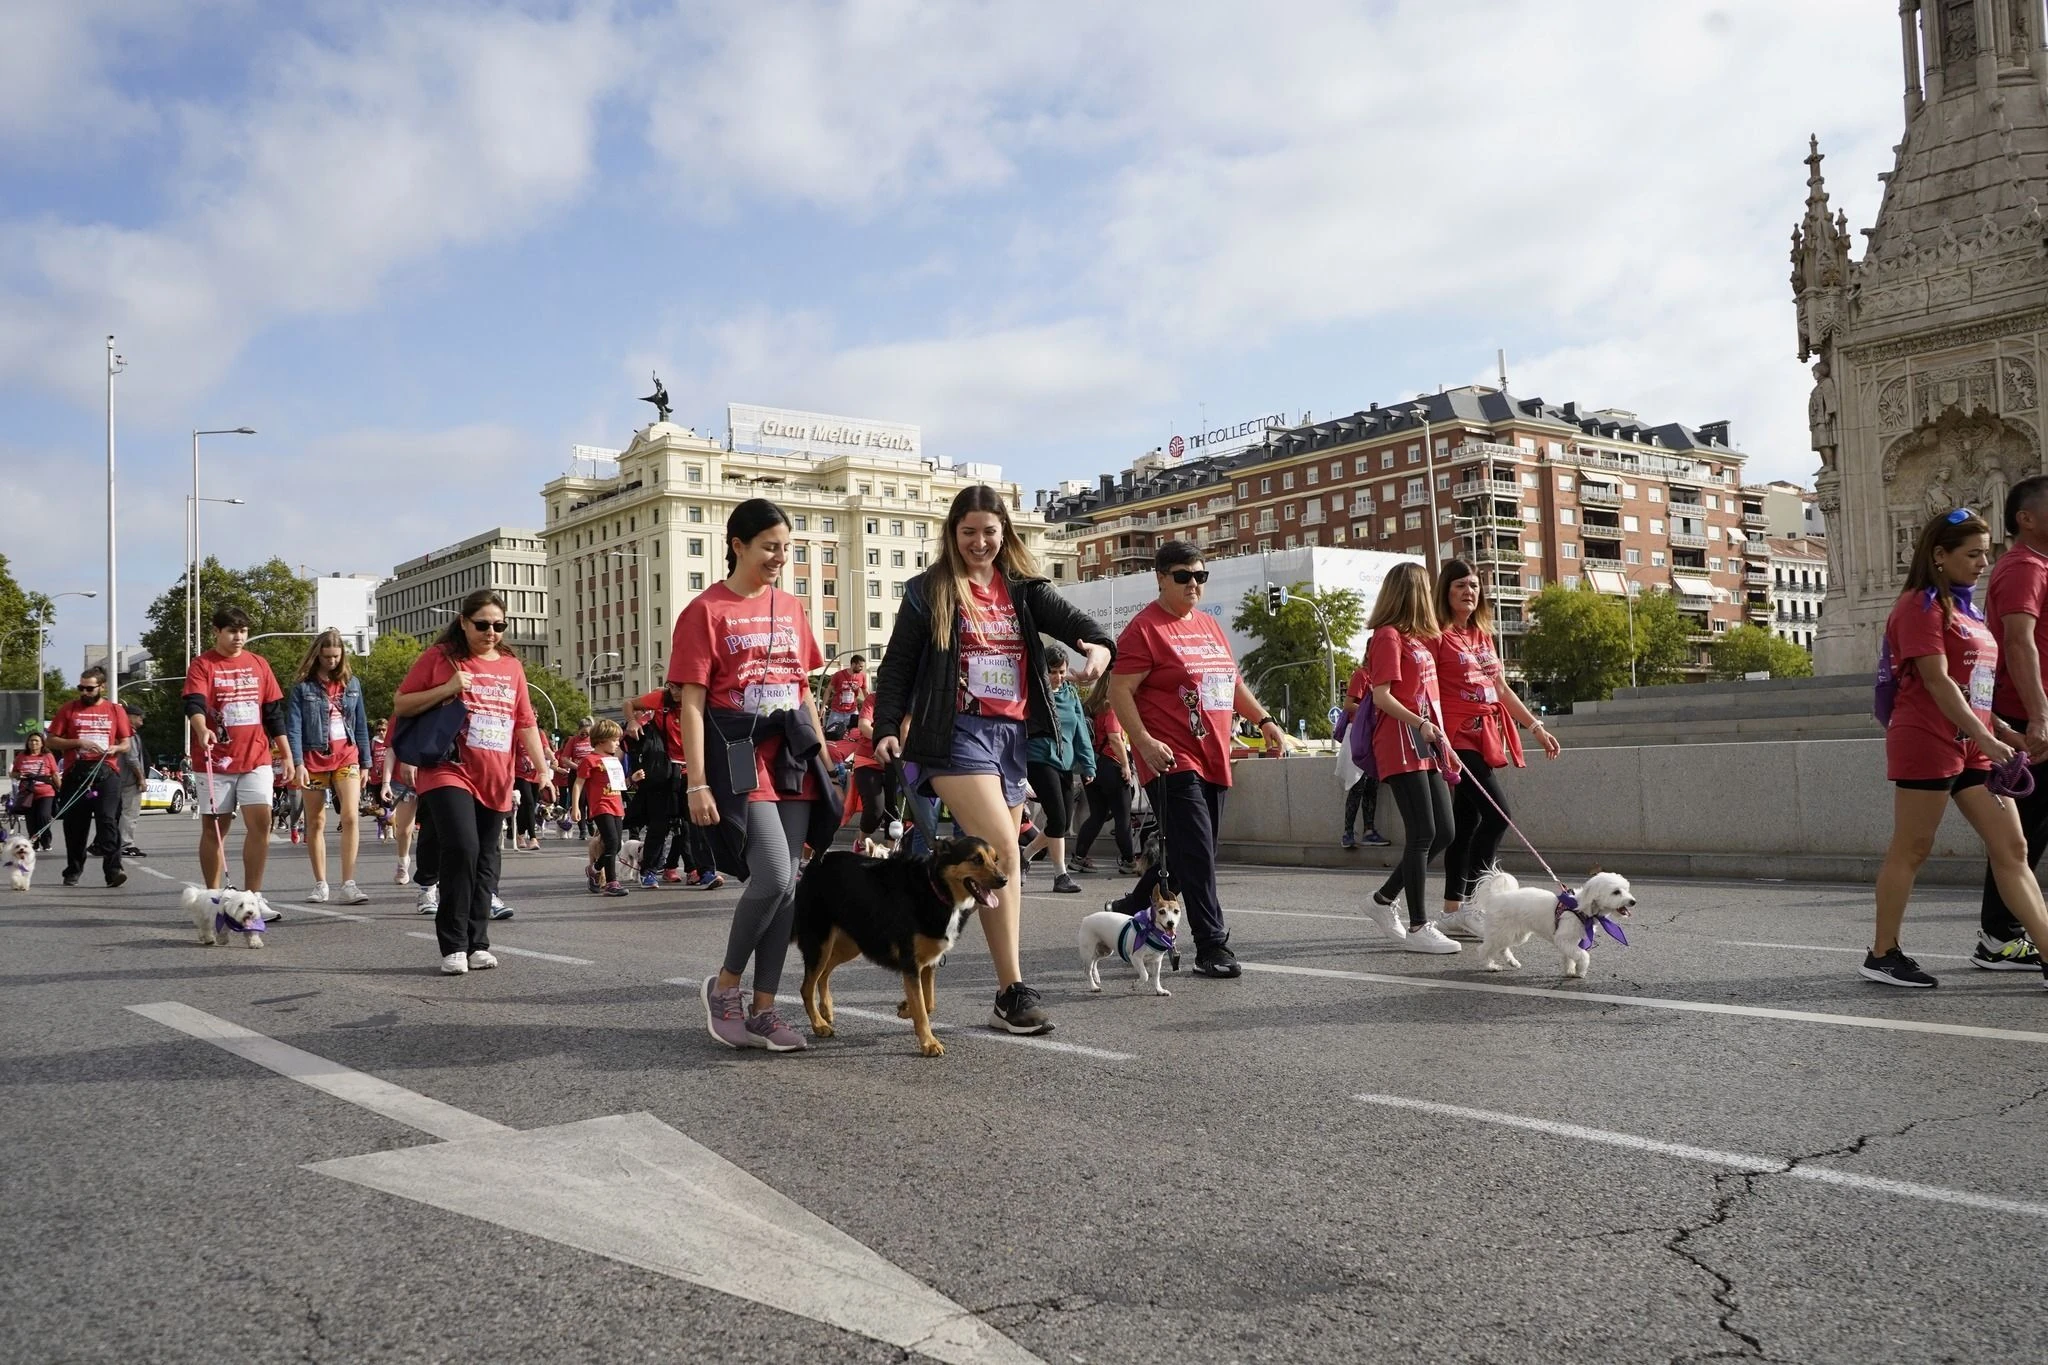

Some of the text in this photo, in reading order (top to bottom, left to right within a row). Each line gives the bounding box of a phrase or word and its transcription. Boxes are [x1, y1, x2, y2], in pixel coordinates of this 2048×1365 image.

[762, 417, 806, 439] Gran
[1207, 412, 1286, 445] COLLECTION
[1097, 607, 1108, 617] los
[984, 685, 1014, 697] Adopta
[146, 783, 168, 793] OLICIA
